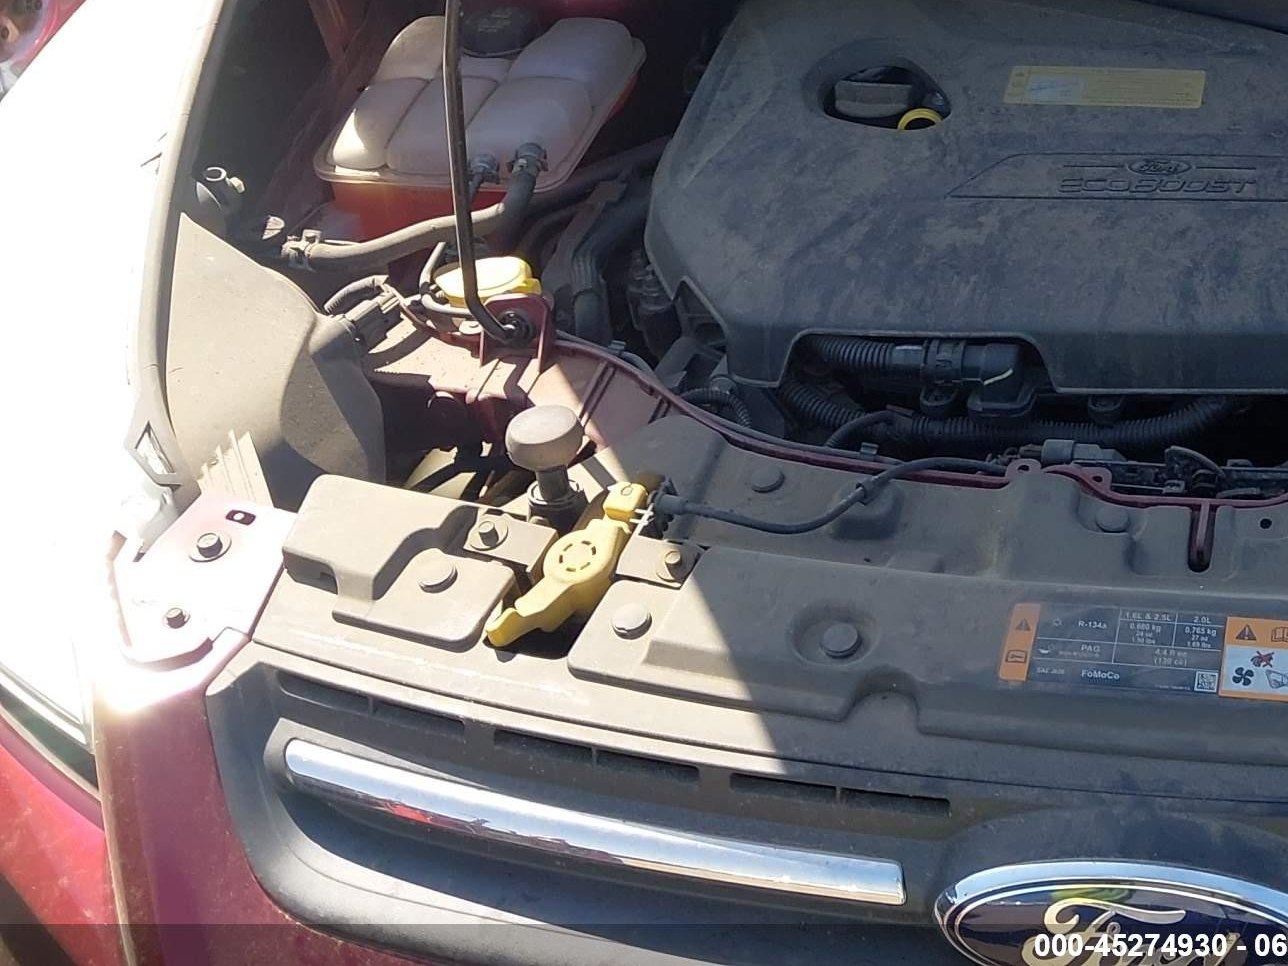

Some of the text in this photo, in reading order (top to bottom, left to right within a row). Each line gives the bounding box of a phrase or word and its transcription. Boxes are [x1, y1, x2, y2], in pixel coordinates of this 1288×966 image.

[1193, 615, 1212, 624] 2.0L
[1206, 628, 1217, 638] kg
[1081, 668, 1120, 680] FoMoCo
